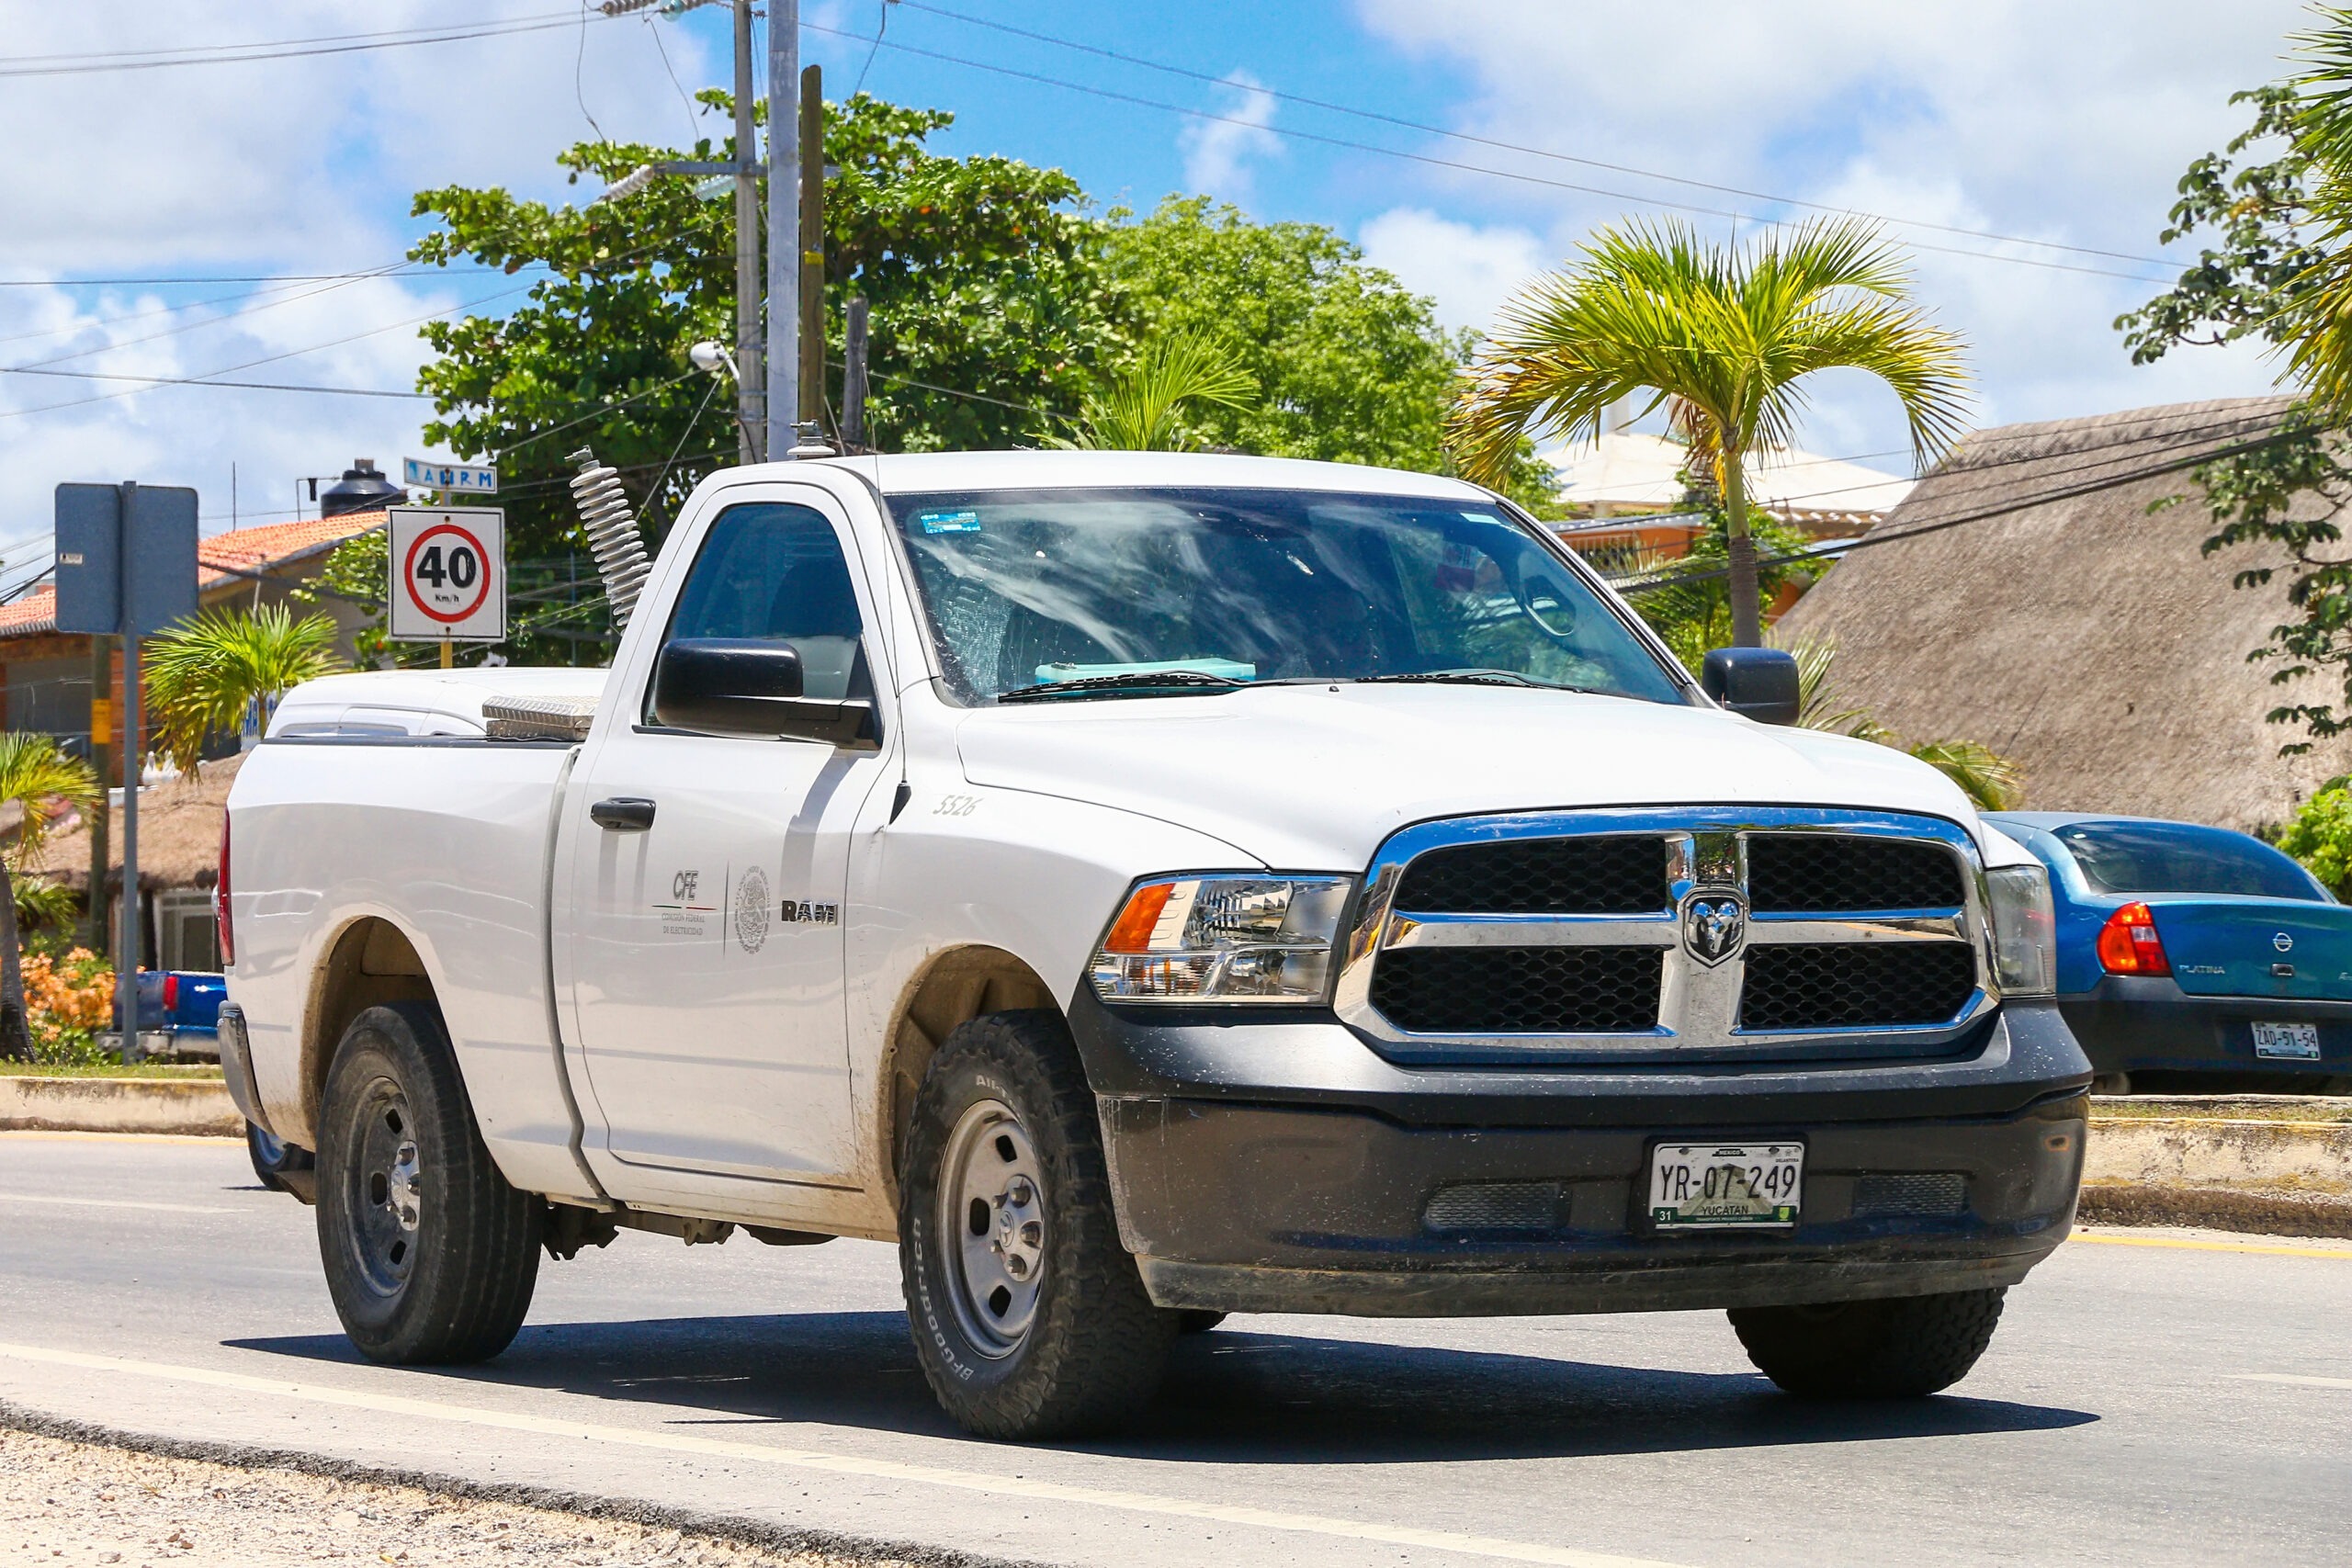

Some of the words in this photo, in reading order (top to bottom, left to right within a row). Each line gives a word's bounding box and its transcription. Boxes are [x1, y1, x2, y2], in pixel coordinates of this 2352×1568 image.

[416, 546, 477, 588] 40
[435, 593, 459, 603] Km/h
[933, 795, 984, 816] 5526
[673, 870, 698, 900] CFE
[782, 899, 838, 926] RAM
[2178, 964, 2225, 974] PLATINA
[1660, 1165, 1796, 1201] YR-07-249
[1659, 1211, 1671, 1222] 31
[1702, 1205, 1749, 1215] YUCATAN
